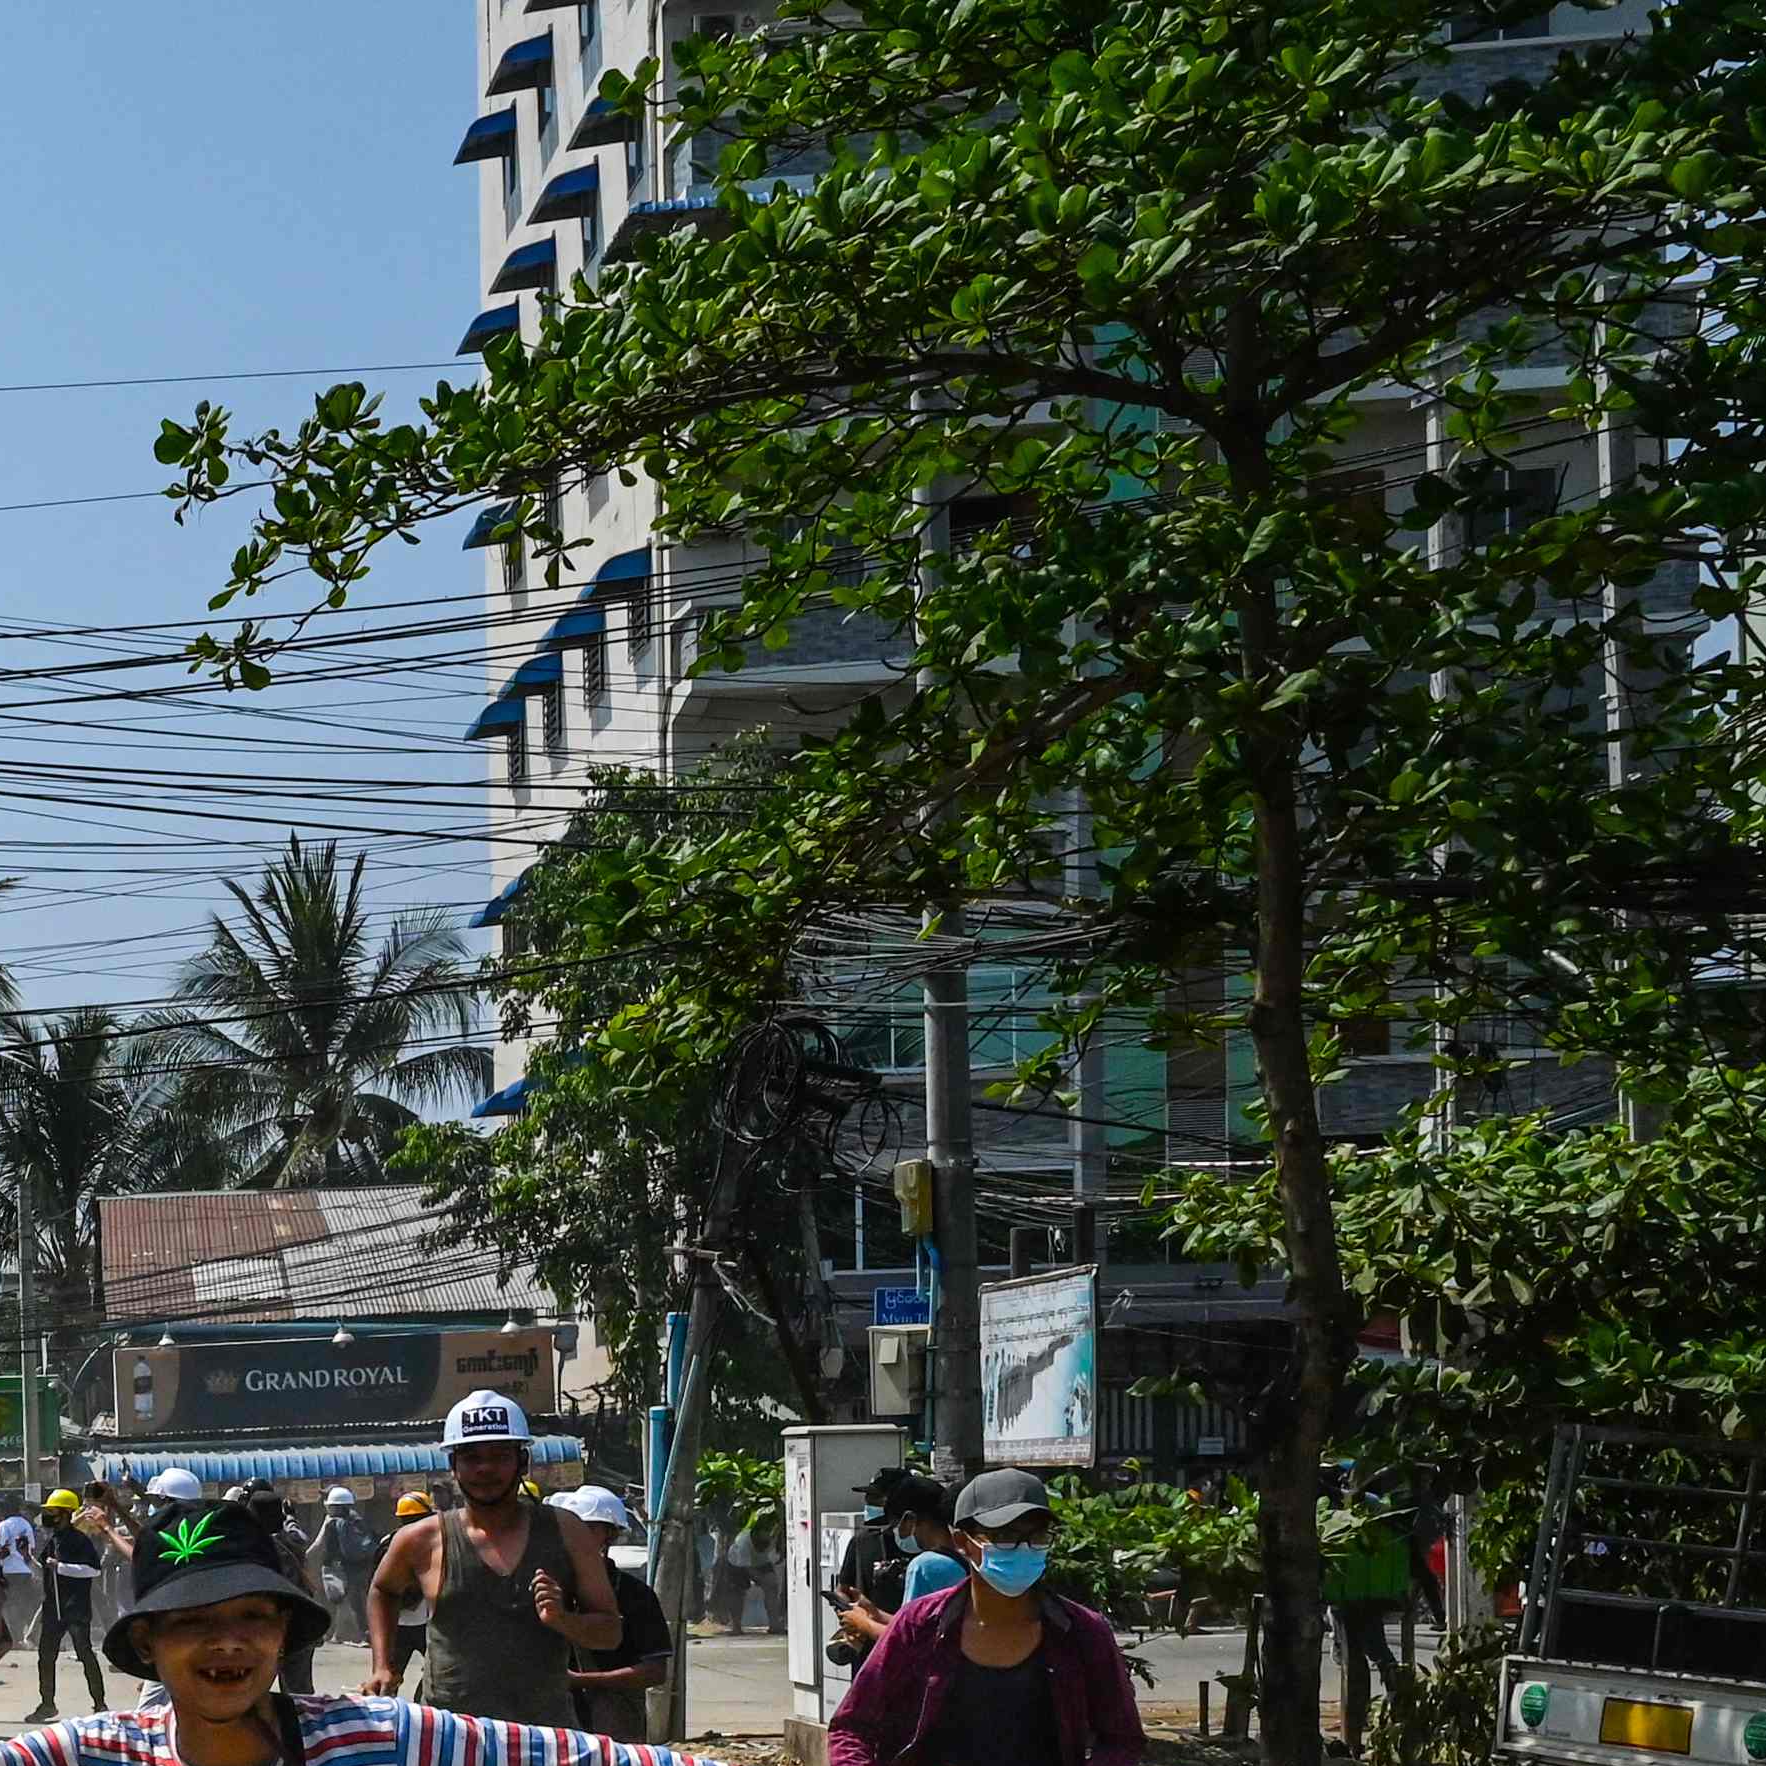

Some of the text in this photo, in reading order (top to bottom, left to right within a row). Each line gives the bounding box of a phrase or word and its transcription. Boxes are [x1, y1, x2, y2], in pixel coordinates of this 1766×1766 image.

[245, 1366, 409, 1392] GRAND ROYAL
[465, 1408, 504, 1423] TKT
[462, 1424, 508, 1434] Generation
